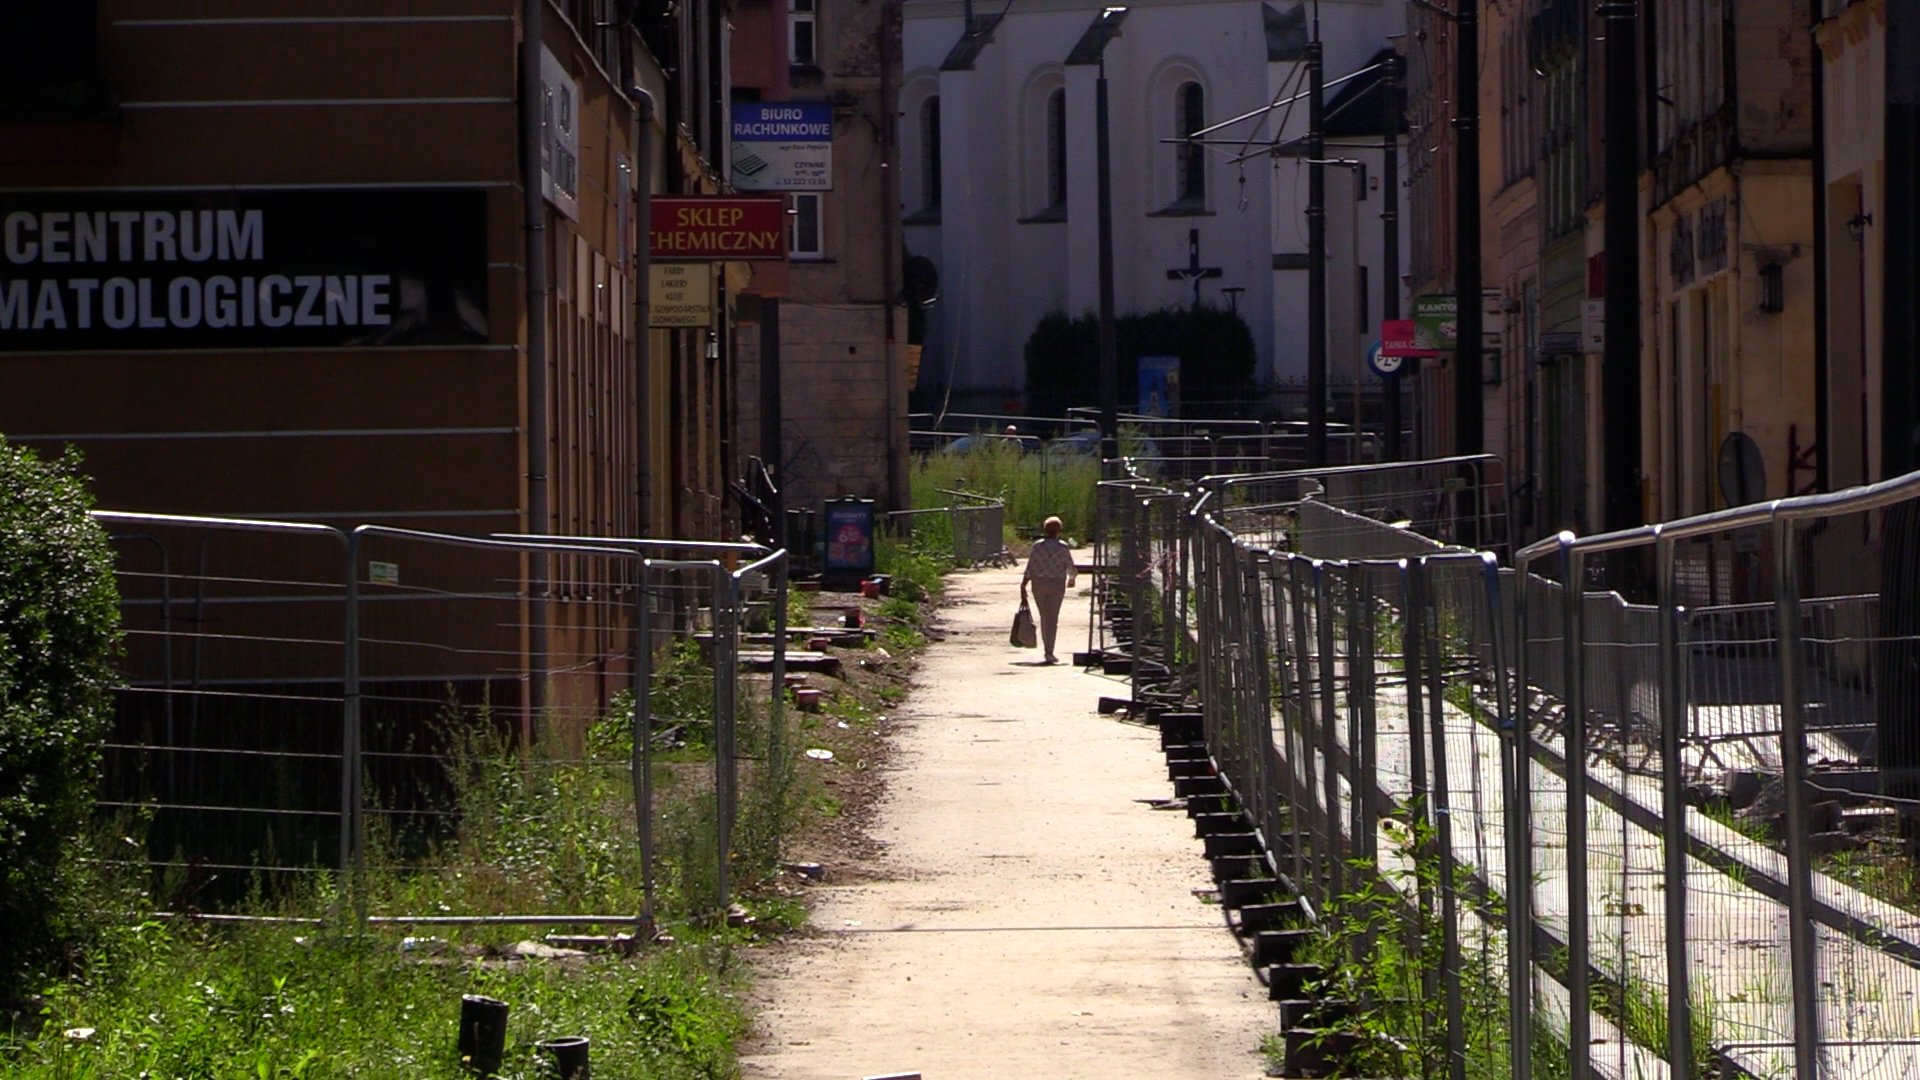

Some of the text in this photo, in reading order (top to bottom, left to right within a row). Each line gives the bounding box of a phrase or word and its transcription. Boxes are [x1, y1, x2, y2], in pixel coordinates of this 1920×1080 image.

[760, 108, 803, 121] BIURO
[734, 123, 830, 135] RACHUNKOWE
[677, 208, 744, 227] SKLEP
[4, 209, 264, 264] CENTRUM
[1417, 303, 1457, 312] KANTO
